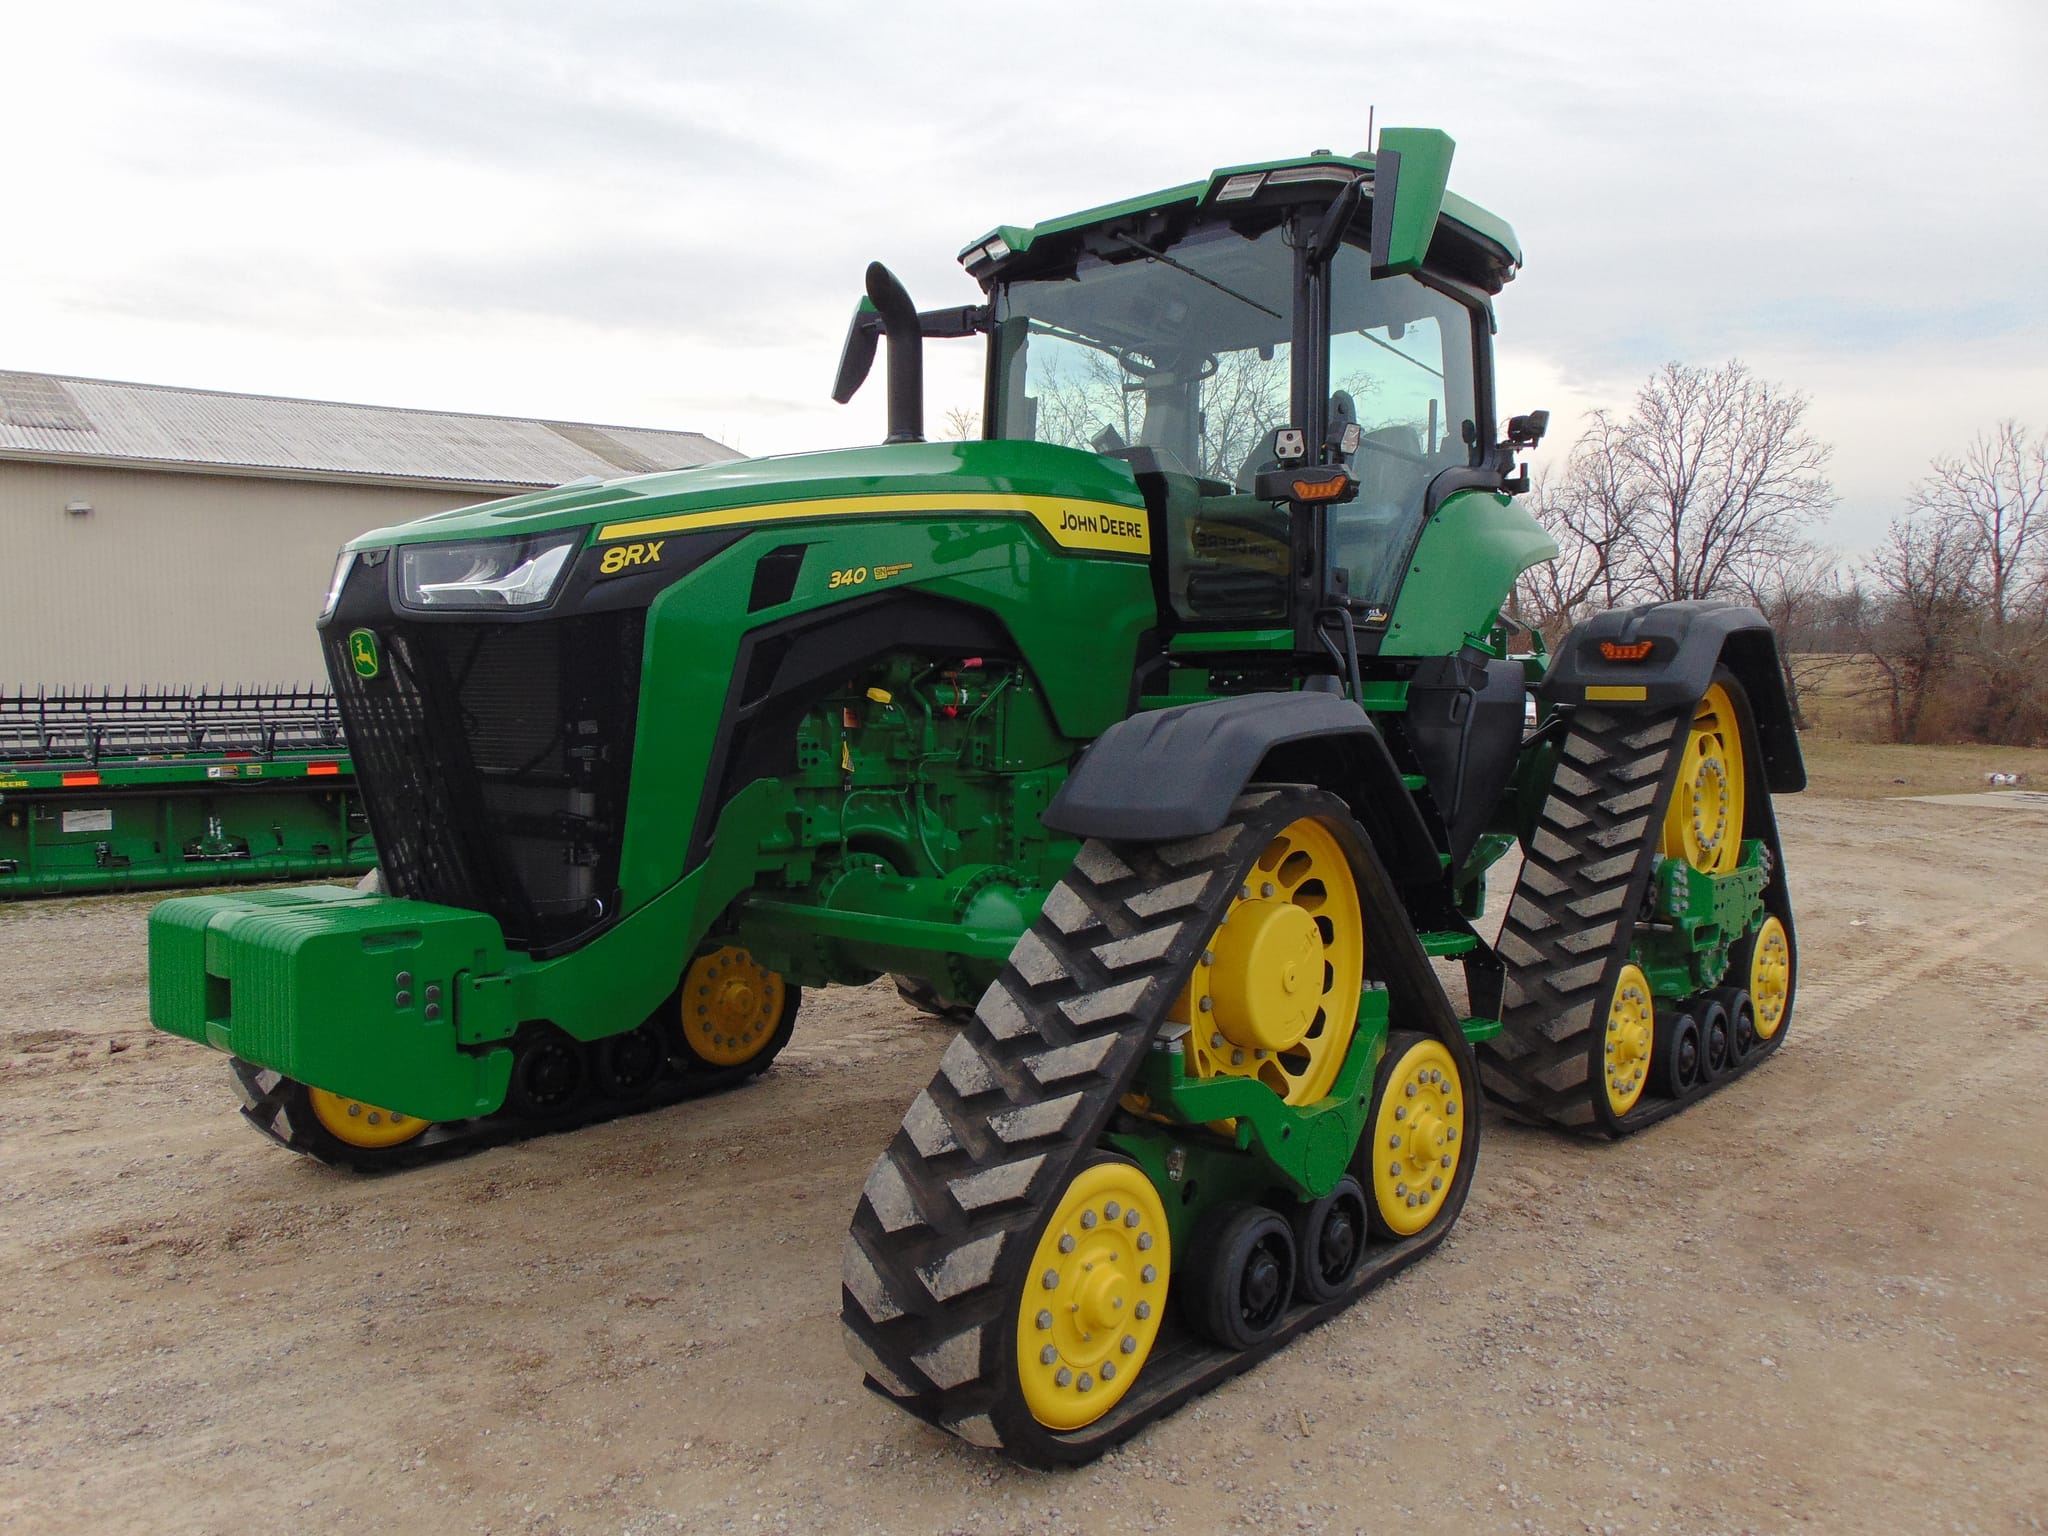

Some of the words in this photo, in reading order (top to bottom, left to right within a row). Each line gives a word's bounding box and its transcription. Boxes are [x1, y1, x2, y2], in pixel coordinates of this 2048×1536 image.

[1060, 510, 1097, 533] JOHN
[1100, 515, 1142, 538] DEERE
[600, 541, 665, 574] 8RX
[829, 567, 867, 588] 340
[0, 780, 29, 788] EERE
